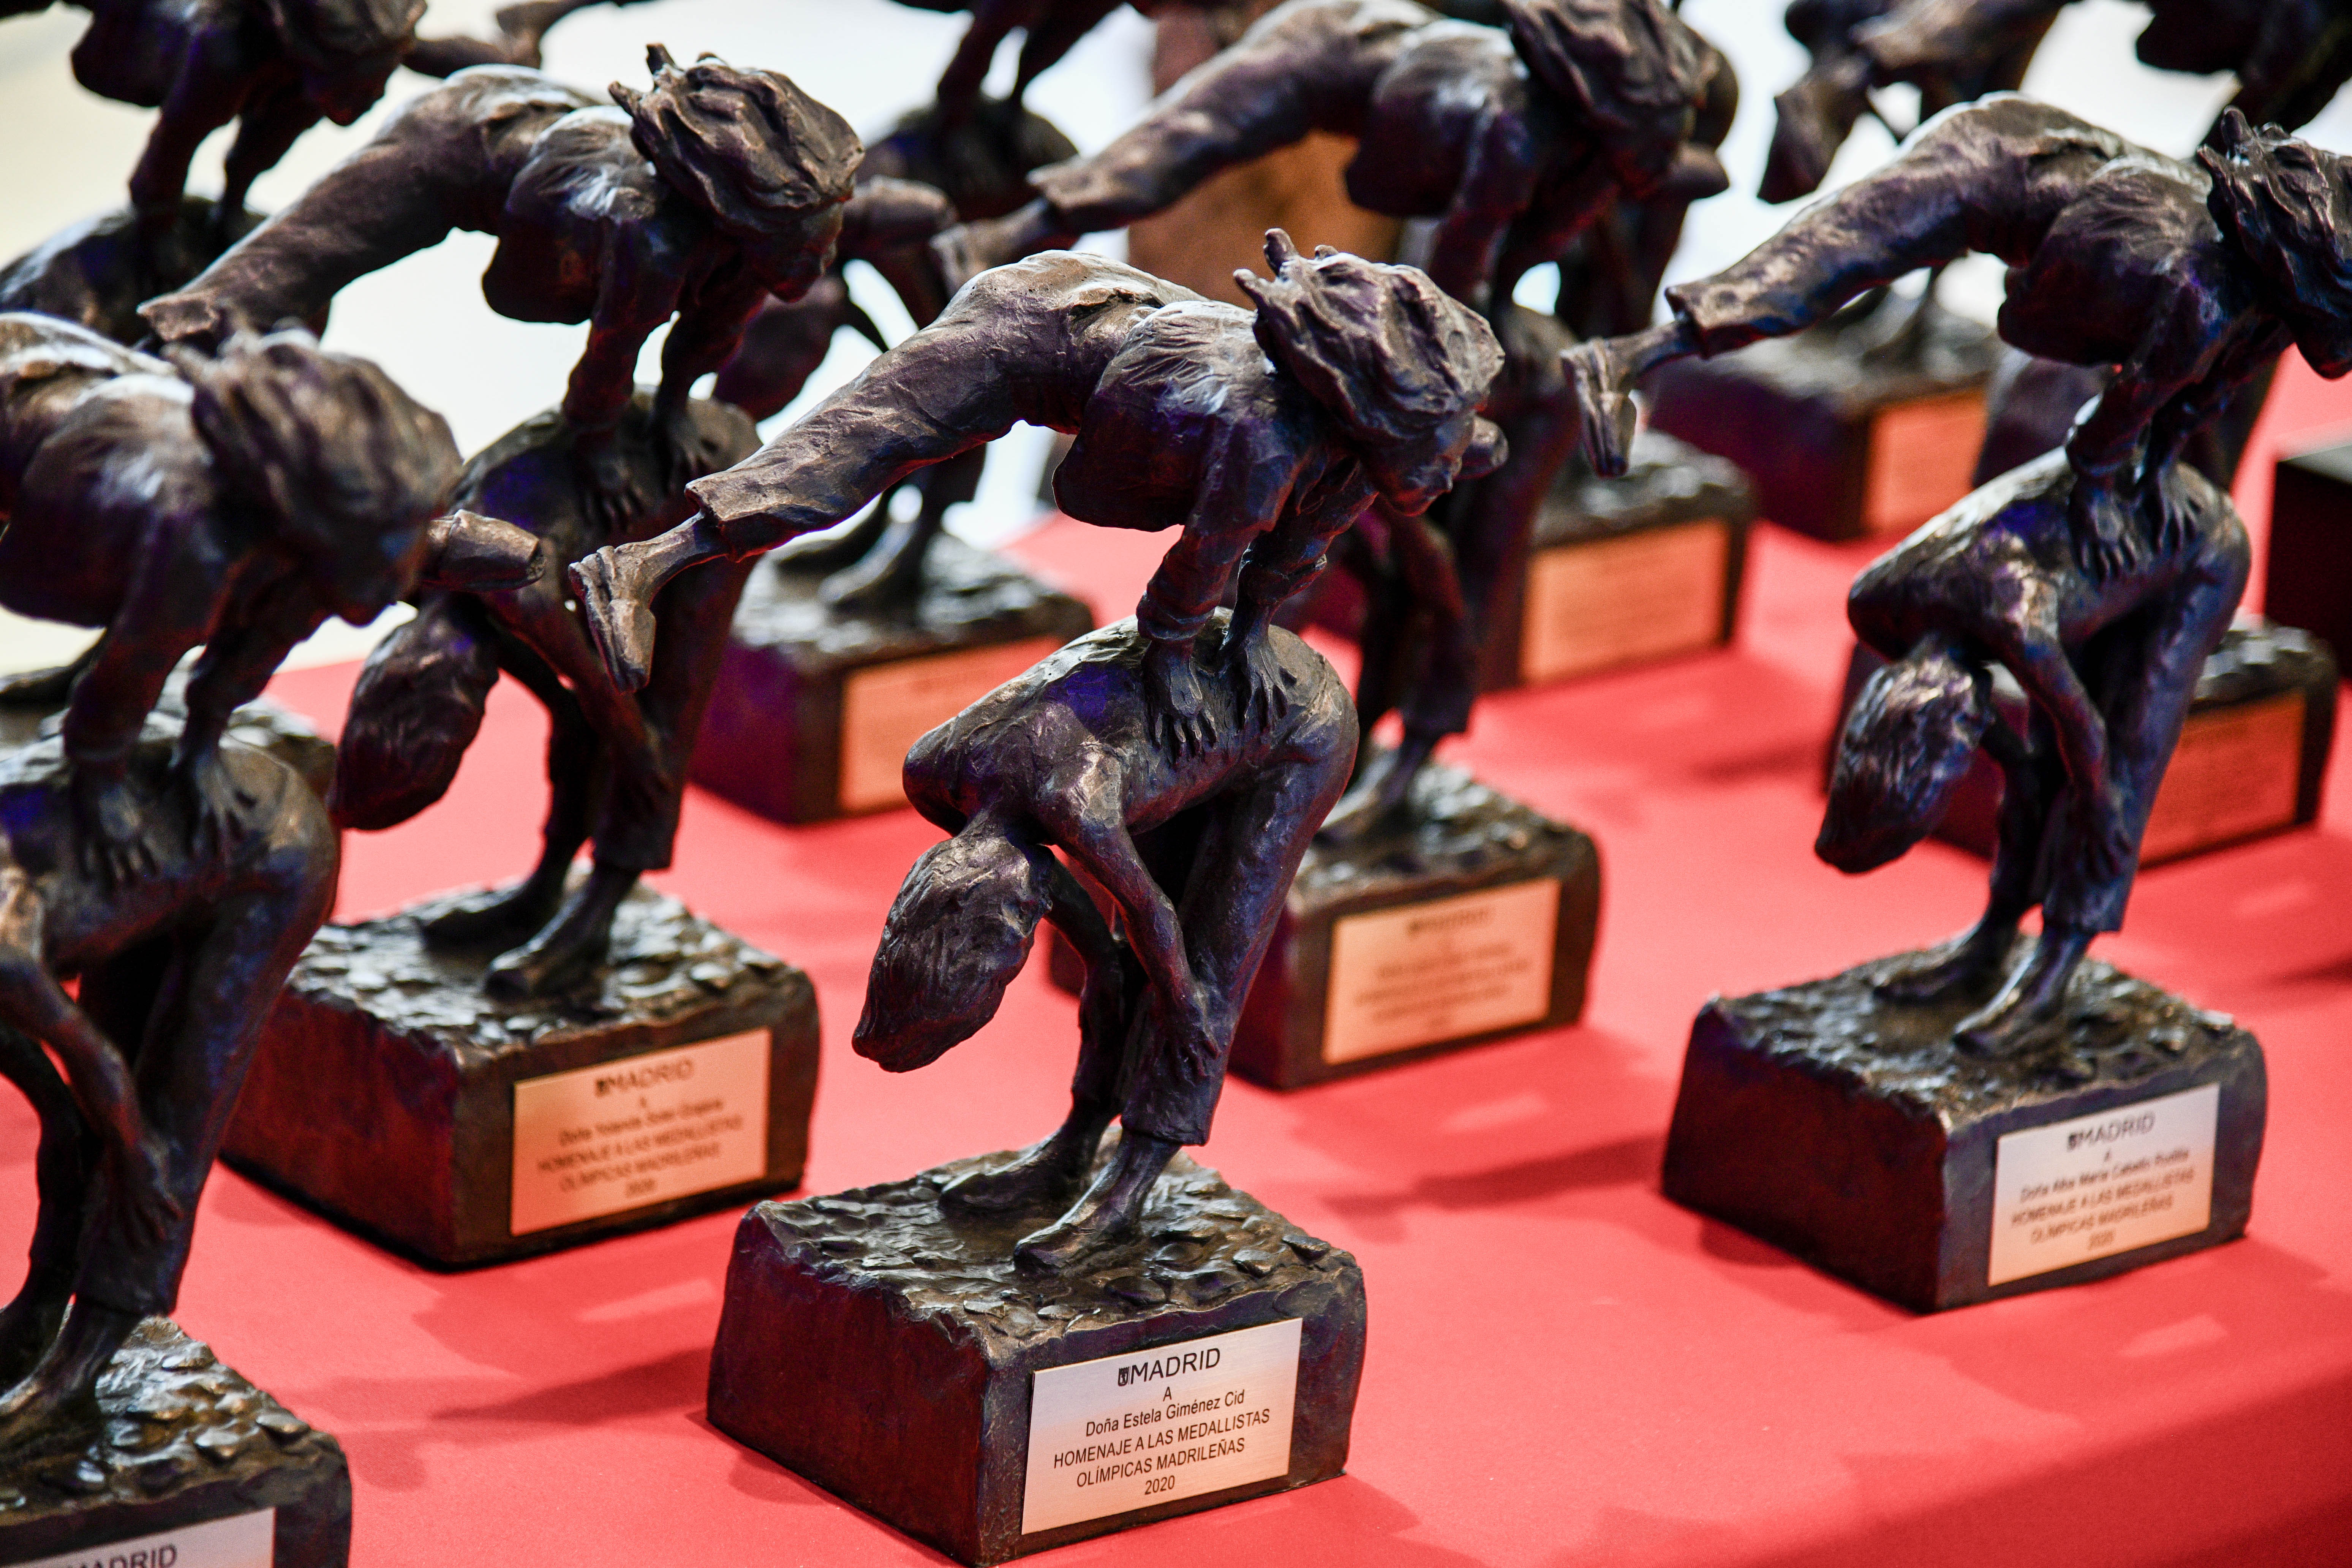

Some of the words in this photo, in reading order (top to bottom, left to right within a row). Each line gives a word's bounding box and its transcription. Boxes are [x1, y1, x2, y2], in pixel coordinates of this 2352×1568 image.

[2079, 1112, 2156, 1145] MADRID
[2012, 1197, 2075, 1227] HOMENAJE
[2091, 1188, 2112, 1206] LAS
[2116, 1167, 2195, 1199] MEDALLISTAS
[1130, 1348, 1221, 1385] MADRID
[1086, 1419, 1119, 1437] Doña
[1124, 1409, 1162, 1428] Estela
[1166, 1397, 1220, 1420] Giménez
[1224, 1389, 1245, 1406] Cid
[1163, 1386, 1172, 1402] A
[1054, 1438, 1132, 1469] HOMENAJE
[1135, 1436, 1144, 1452] A
[1148, 1430, 1174, 1447] LAS
[1178, 1408, 1270, 1442] MEDALLISTAS
[1077, 1458, 1152, 1488] OLÍMPICAS
[1156, 1437, 1246, 1470] MADRILEÑAS
[1144, 1475, 1176, 1495] 2020
